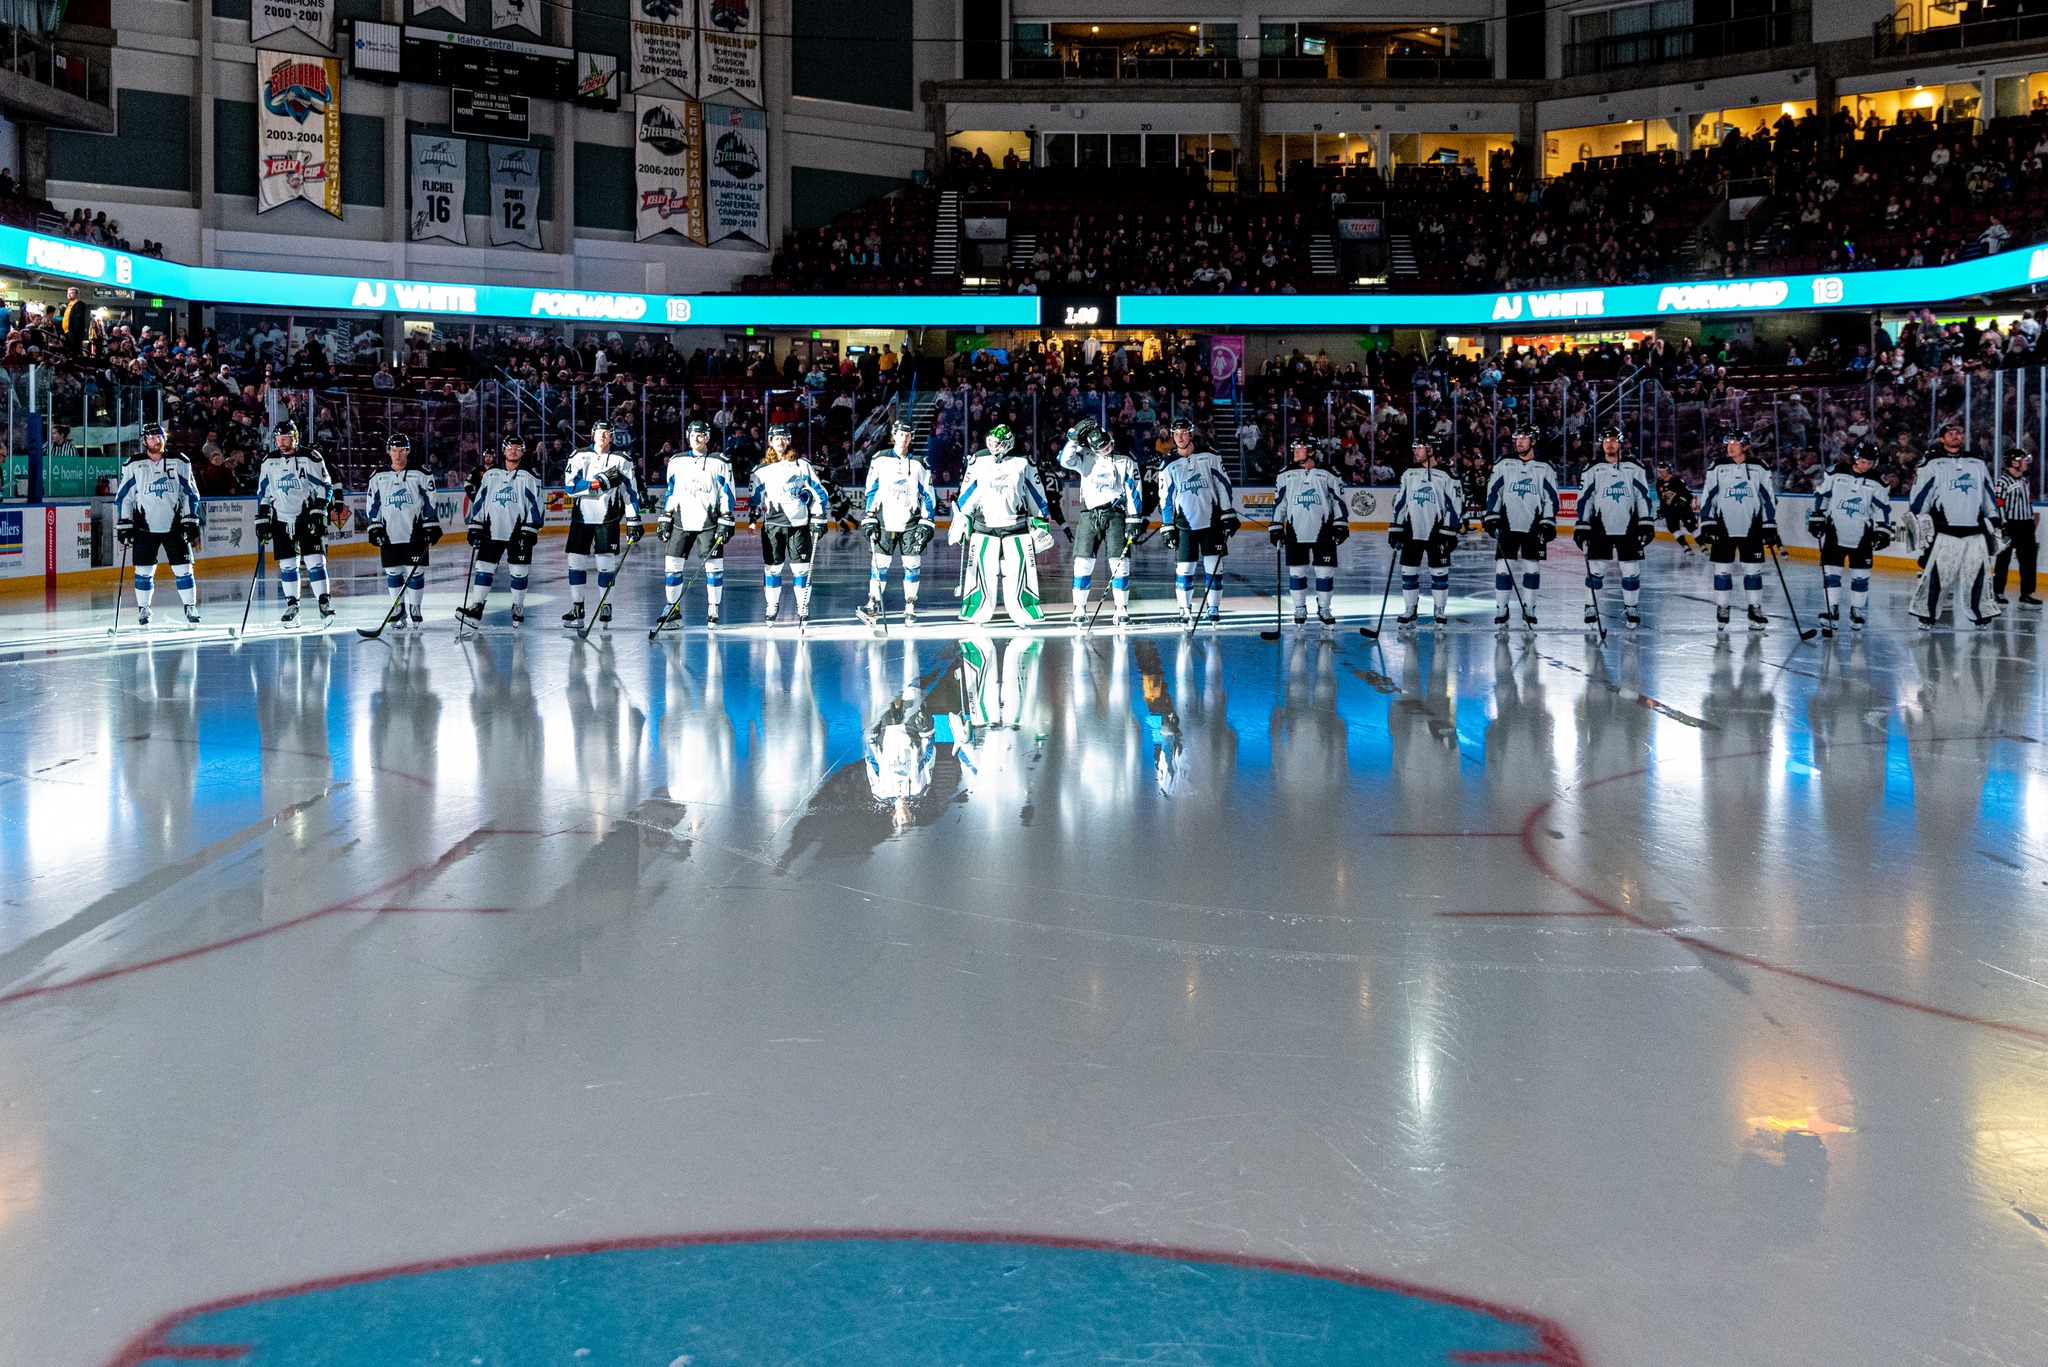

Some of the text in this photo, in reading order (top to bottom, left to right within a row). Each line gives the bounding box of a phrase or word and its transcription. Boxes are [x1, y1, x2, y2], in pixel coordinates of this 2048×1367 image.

[634, 22, 692, 40] FOUNDERS CUP
[457, 34, 481, 47] Idaho
[482, 38, 515, 51] Central
[644, 38, 681, 49] NORTHERN
[704, 32, 757, 50] FOUNDERS CUP
[648, 47, 678, 57] DIVISION
[713, 47, 747, 59] NORTHERN
[642, 56, 683, 67] CHAMPIONS
[503, 68, 519, 76] GUEST
[712, 64, 750, 76] CHAMPIONS
[271, 63, 327, 98] STEELHEADS
[457, 106, 474, 116] HOME
[508, 113, 526, 122] GUEST
[639, 123, 688, 144] STEELHEADS
[1140, 123, 1152, 131] 20
[1313, 123, 1322, 131] 19
[266, 129, 324, 143] 2003-2004
[270, 160, 323, 178] KELLY CUP
[638, 163, 686, 177] 2006-2007
[422, 180, 455, 194] FLICHEL
[709, 179, 764, 191] BRABHAM CUP
[646, 194, 667, 206] KELLY
[689, 151, 702, 237] CHAMPIONS
[720, 192, 755, 202] NATIONAL
[426, 195, 451, 224] 16
[714, 199, 761, 210] CONFERENCE
[503, 201, 526, 230] 12
[718, 208, 758, 218] CHAMPIONS
[1350, 223, 1377, 232] TECATE
[26, 236, 106, 278] FORWARD
[351, 281, 691, 322] AJ WHITE FORWARD 18
[1491, 277, 1844, 320] AJ WHITE FORWARD 18
[61, 465, 83, 481] homie
[167, 468, 175, 480] C
[299, 467, 306, 479] A
[144, 482, 175, 495] IDAHO
[427, 480, 435, 491] 3
[1046, 476, 1059, 493] 21
[1180, 478, 1209, 494] IDAHO
[1508, 481, 1537, 496] IDAHO
[493, 490, 518, 503] IDAHO
[1602, 486, 1630, 499] IDAHO
[1724, 486, 1753, 499] IDAHO
[385, 493, 413, 506] IDAHO
[1294, 494, 1321, 506] IDAHO
